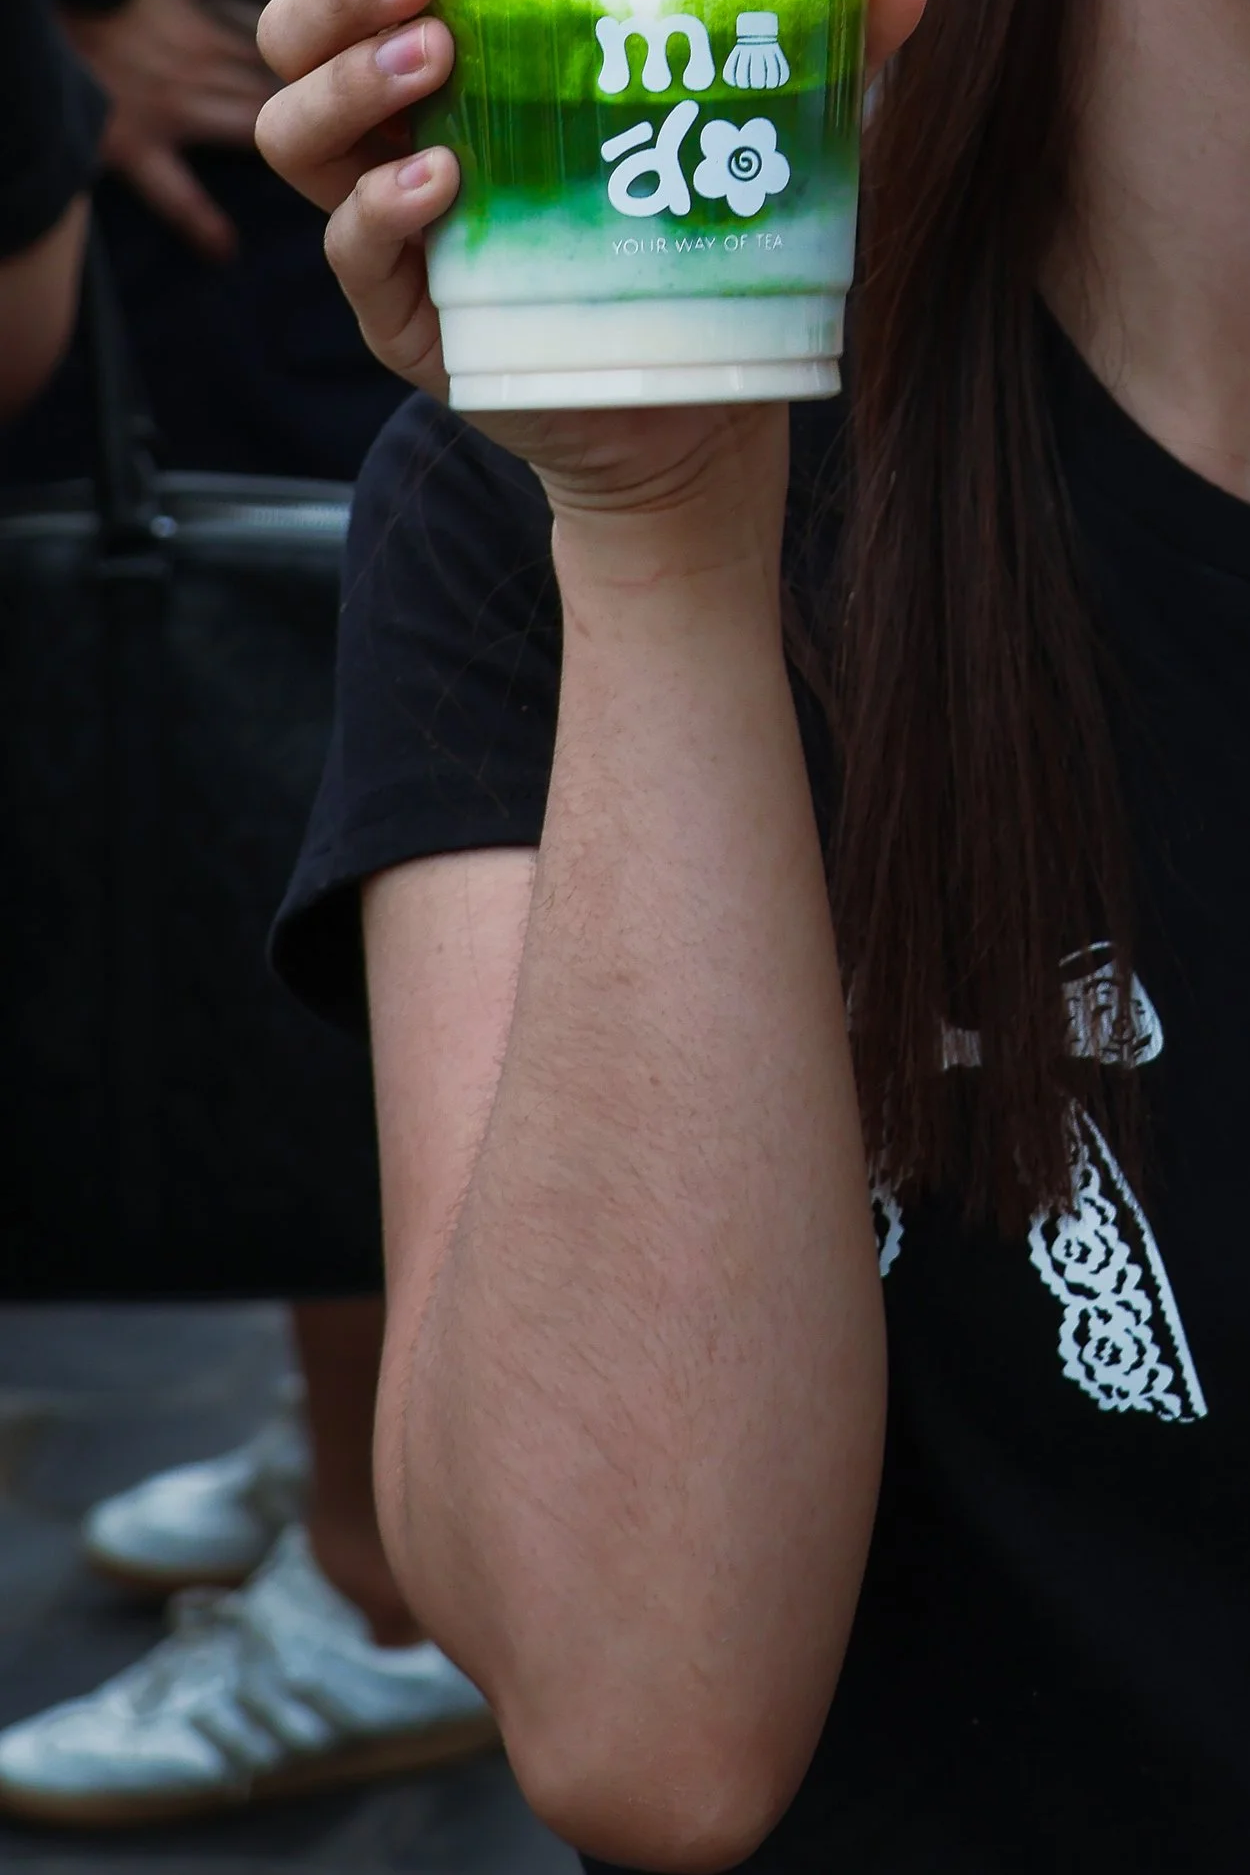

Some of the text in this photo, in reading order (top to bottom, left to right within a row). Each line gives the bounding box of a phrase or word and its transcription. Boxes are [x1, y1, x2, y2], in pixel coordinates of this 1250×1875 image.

[612, 233, 784, 256] YOUR WAY OF TEA
